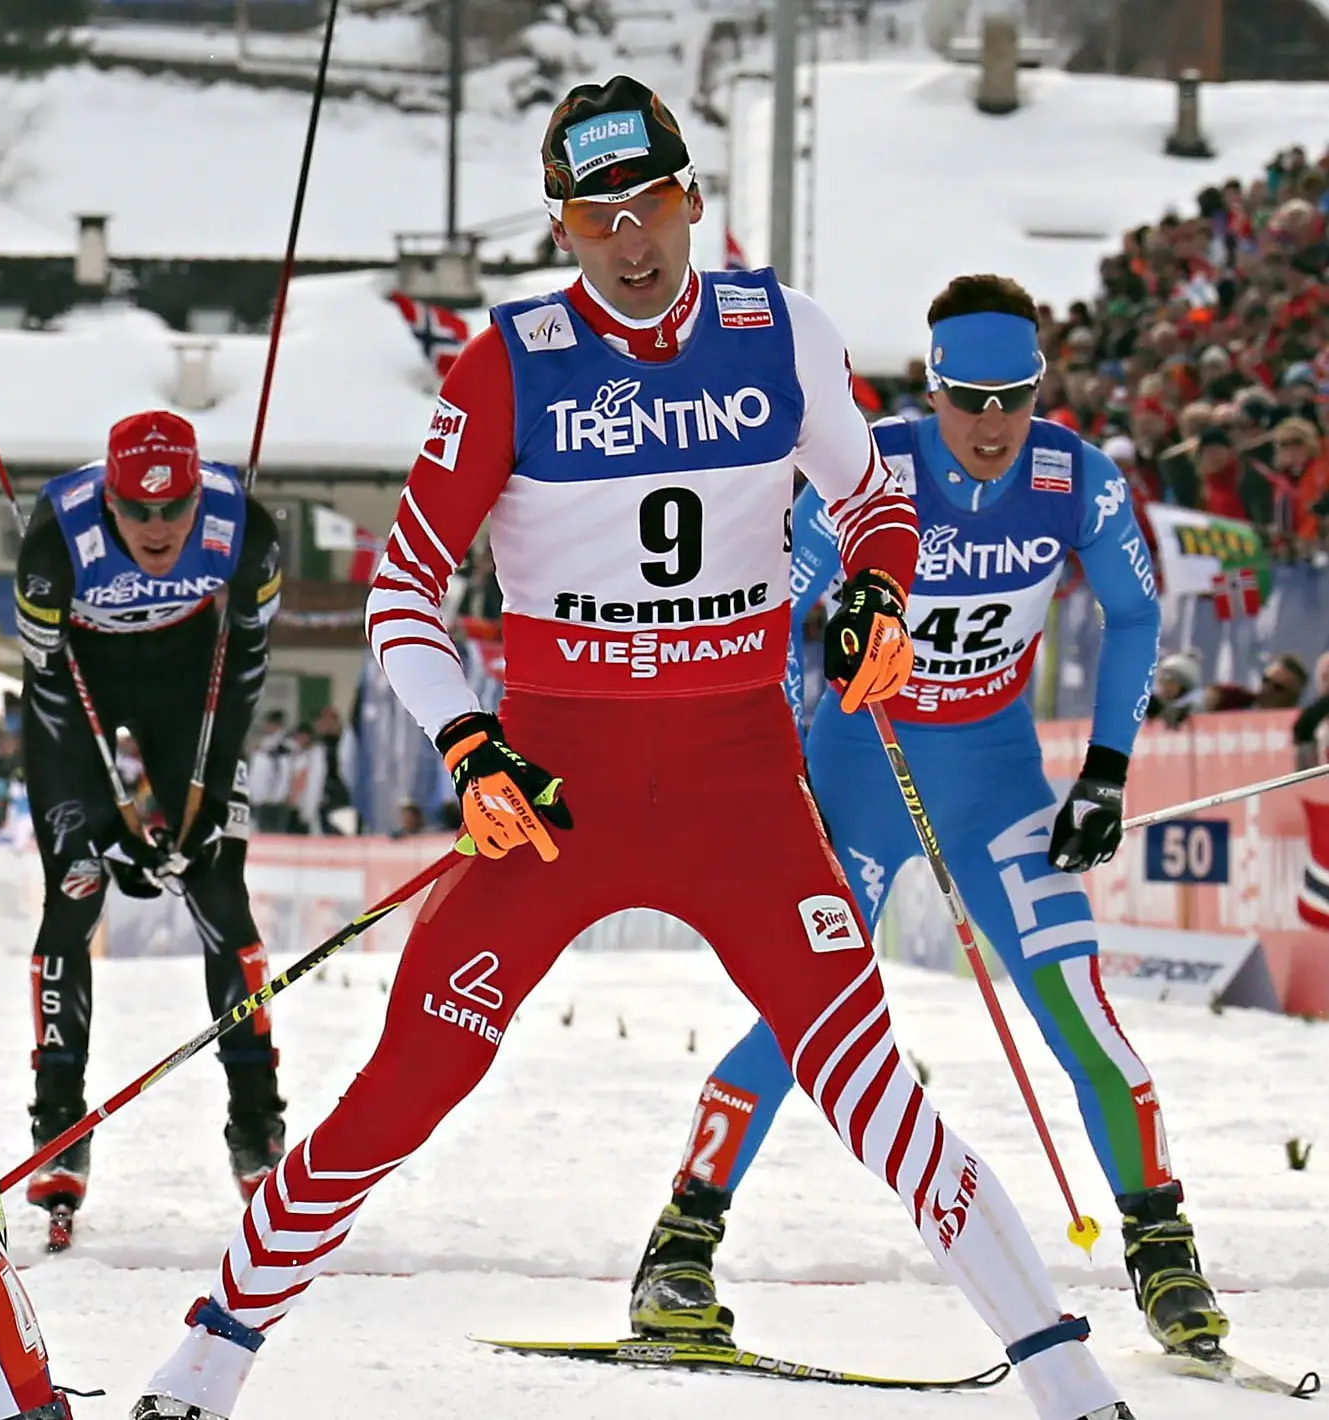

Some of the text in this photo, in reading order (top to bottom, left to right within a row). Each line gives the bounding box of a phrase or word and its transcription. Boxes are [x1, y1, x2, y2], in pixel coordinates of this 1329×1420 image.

[579, 118, 635, 148] stubai
[546, 387, 771, 456] TRENTINO
[639, 486, 704, 588] 9
[84, 575, 224, 606] TRENTINO
[553, 582, 769, 624] fiemme
[556, 629, 766, 679] VIESSMANN
[909, 602, 1013, 655] 42
[501, 785, 537, 832] ziener
[1160, 825, 1214, 879] 50
[41, 956, 65, 1047] USA
